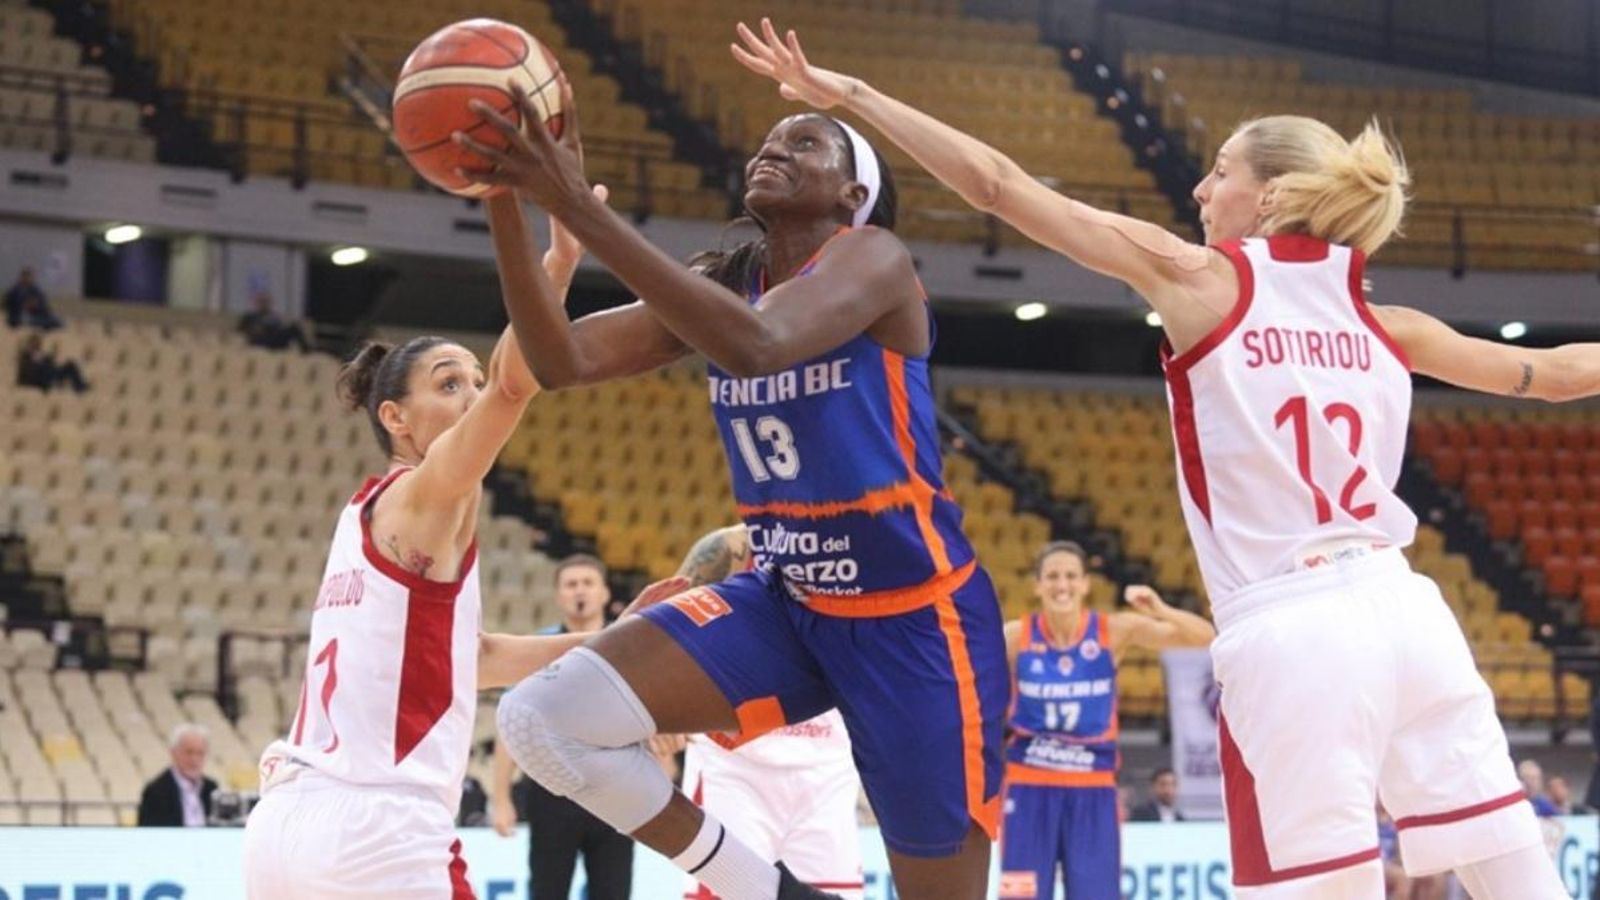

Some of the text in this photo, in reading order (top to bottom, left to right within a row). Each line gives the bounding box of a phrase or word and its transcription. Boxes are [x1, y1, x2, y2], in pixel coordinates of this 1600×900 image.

[1242, 326, 1372, 372] SOTIRIOU
[804, 357, 853, 397] BC
[730, 415, 801, 483] 13
[1274, 395, 1377, 526] 12
[821, 534, 850, 554] del
[752, 554, 858, 583] Eerzo
[1045, 702, 1081, 732] 17
